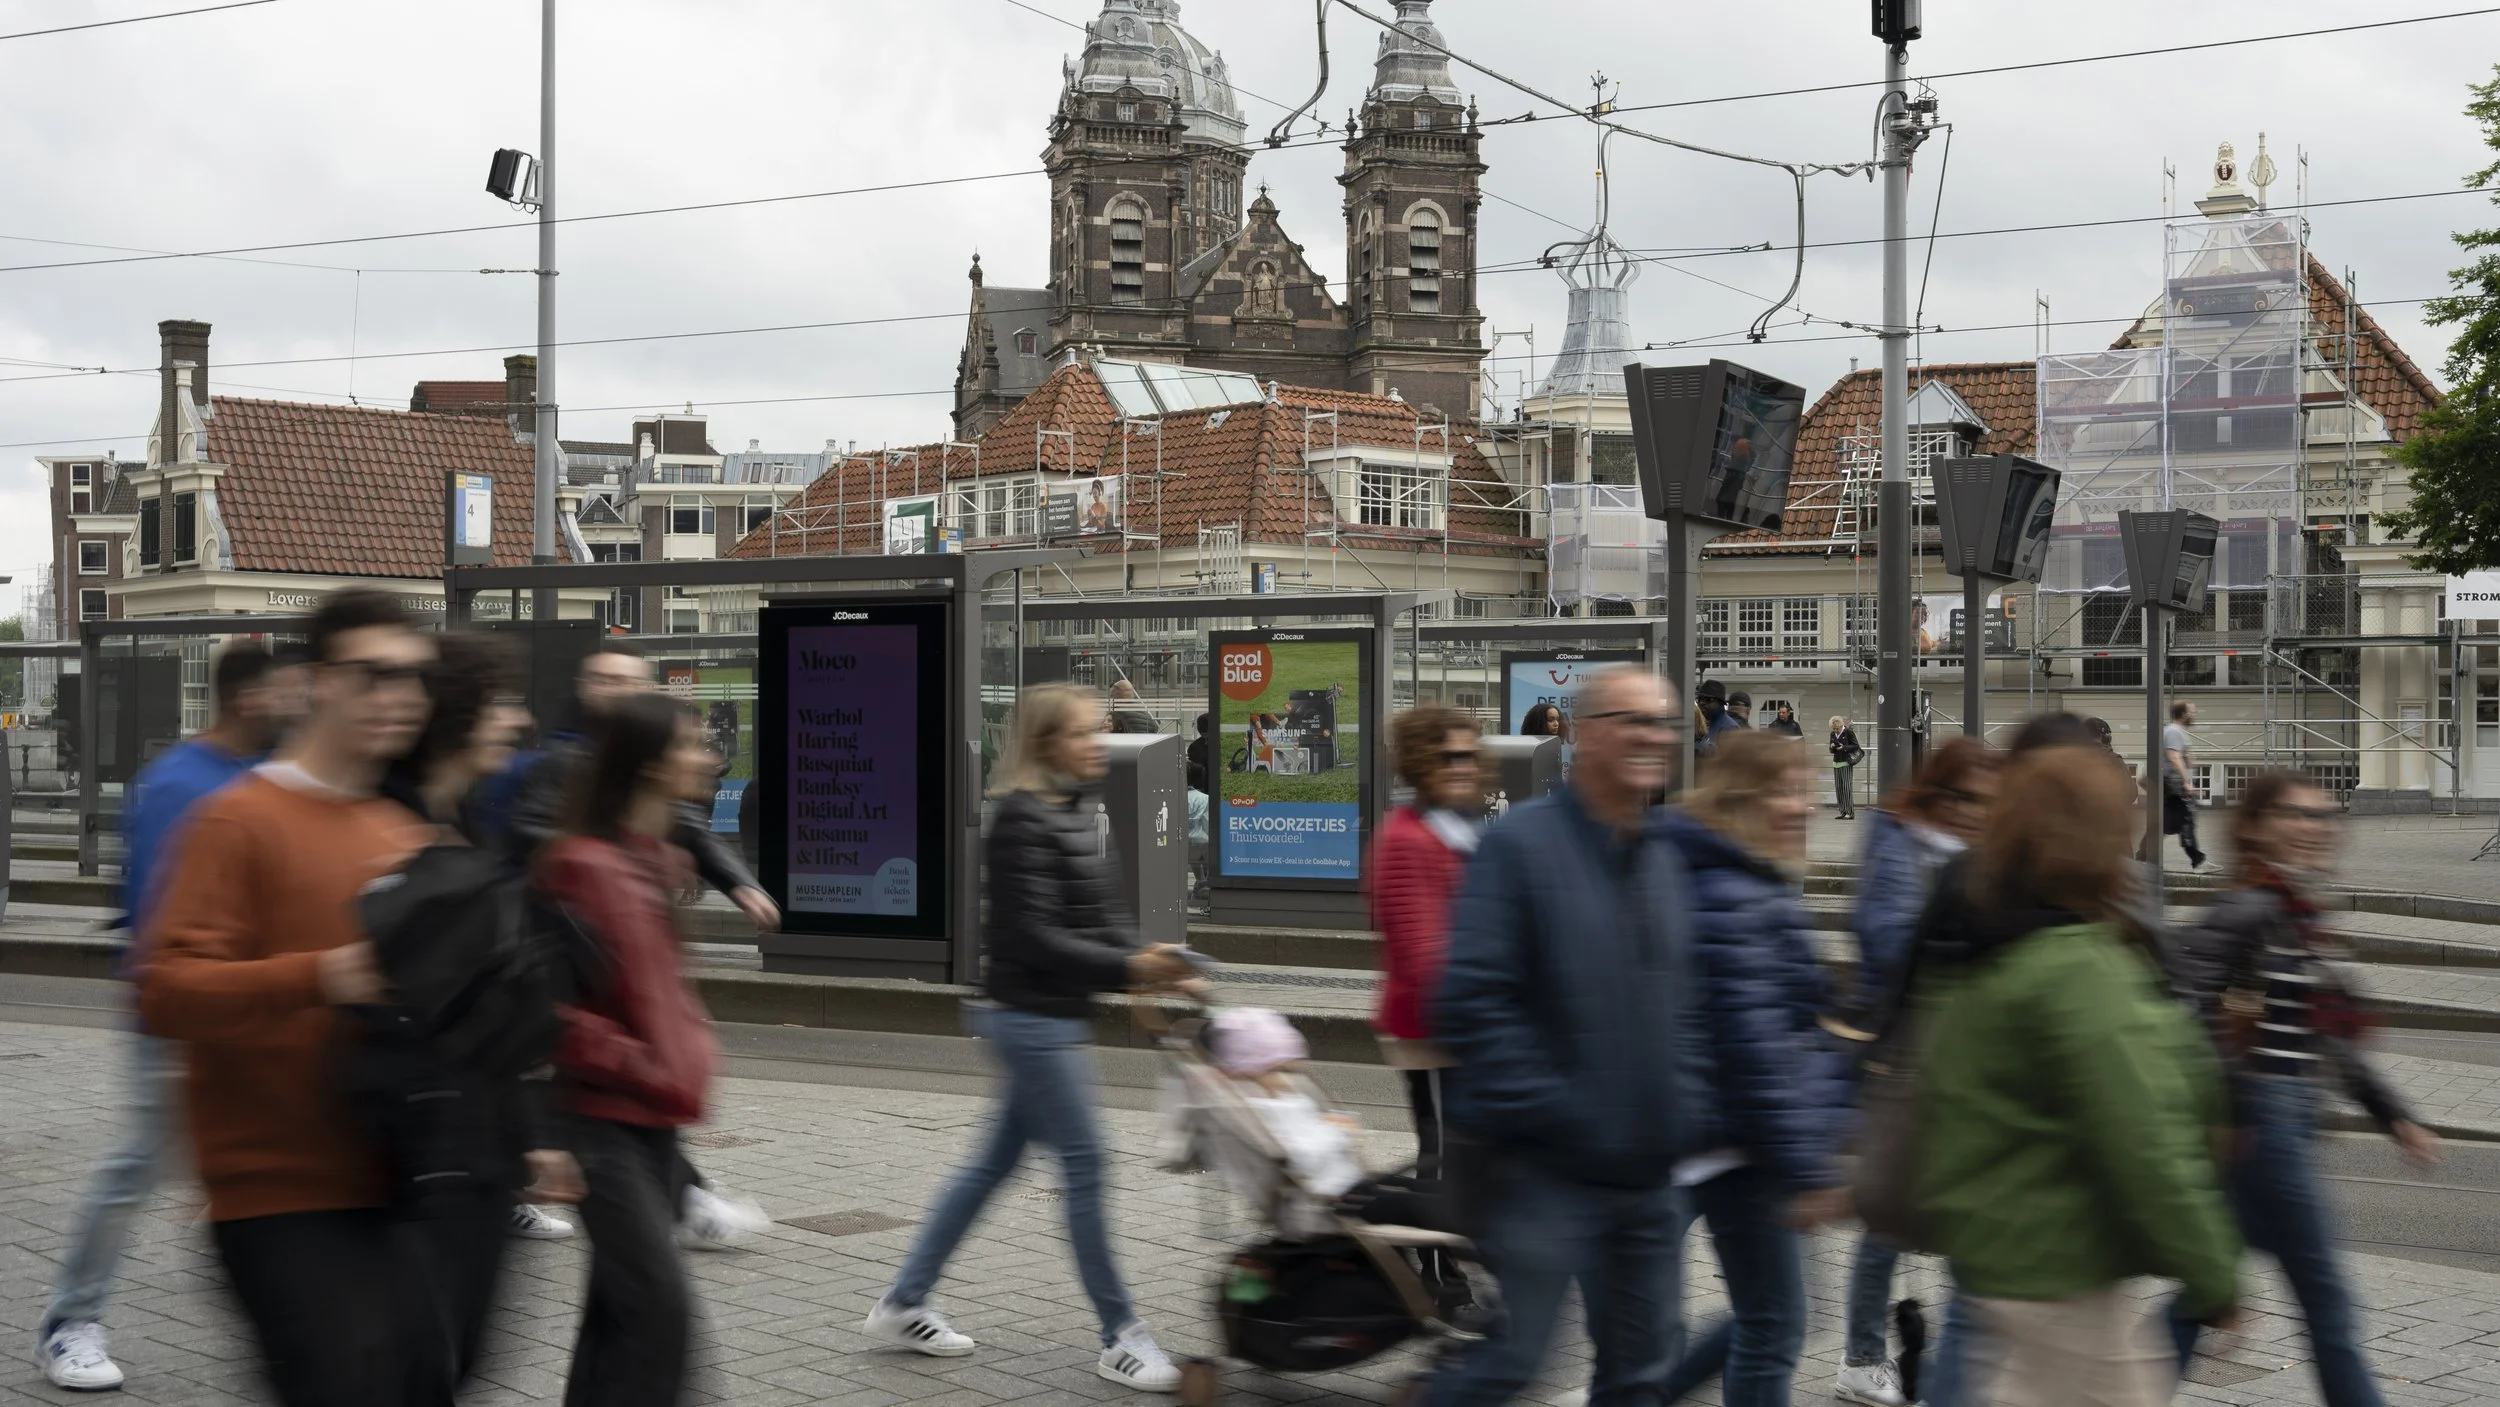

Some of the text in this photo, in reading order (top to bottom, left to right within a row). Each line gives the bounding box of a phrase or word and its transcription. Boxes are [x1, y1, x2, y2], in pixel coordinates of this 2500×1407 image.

[467, 504, 474, 516] 4
[268, 591, 318, 606] Lovers
[832, 611, 869, 620] JCDecaux
[1271, 633, 1305, 641] JCDecaux
[798, 650, 857, 671] Moco
[1223, 651, 1262, 666] cool
[1223, 667, 1262, 682] blue
[1575, 674, 1592, 683] TUI
[798, 708, 863, 726] Warhol
[797, 731, 859, 754] Haring
[797, 755, 875, 777] Basquiat
[797, 778, 863, 801] Banksy
[797, 801, 888, 823] Digital Art
[1229, 816, 1347, 832] EK-VOORZETJES
[797, 825, 869, 842] Kusama
[1230, 831, 1305, 844] Thuisvoordeel.
[796, 847, 860, 866] & Hirst
[1234, 856, 1250, 864] Scoor
[1259, 857, 1274, 866] jouw
[1298, 857, 1304, 865] in
[1304, 857, 1313, 865] de
[1312, 857, 1339, 866] Coolblue
[1339, 858, 1351, 868] App
[796, 884, 862, 897] MUSEUMPLEIN
